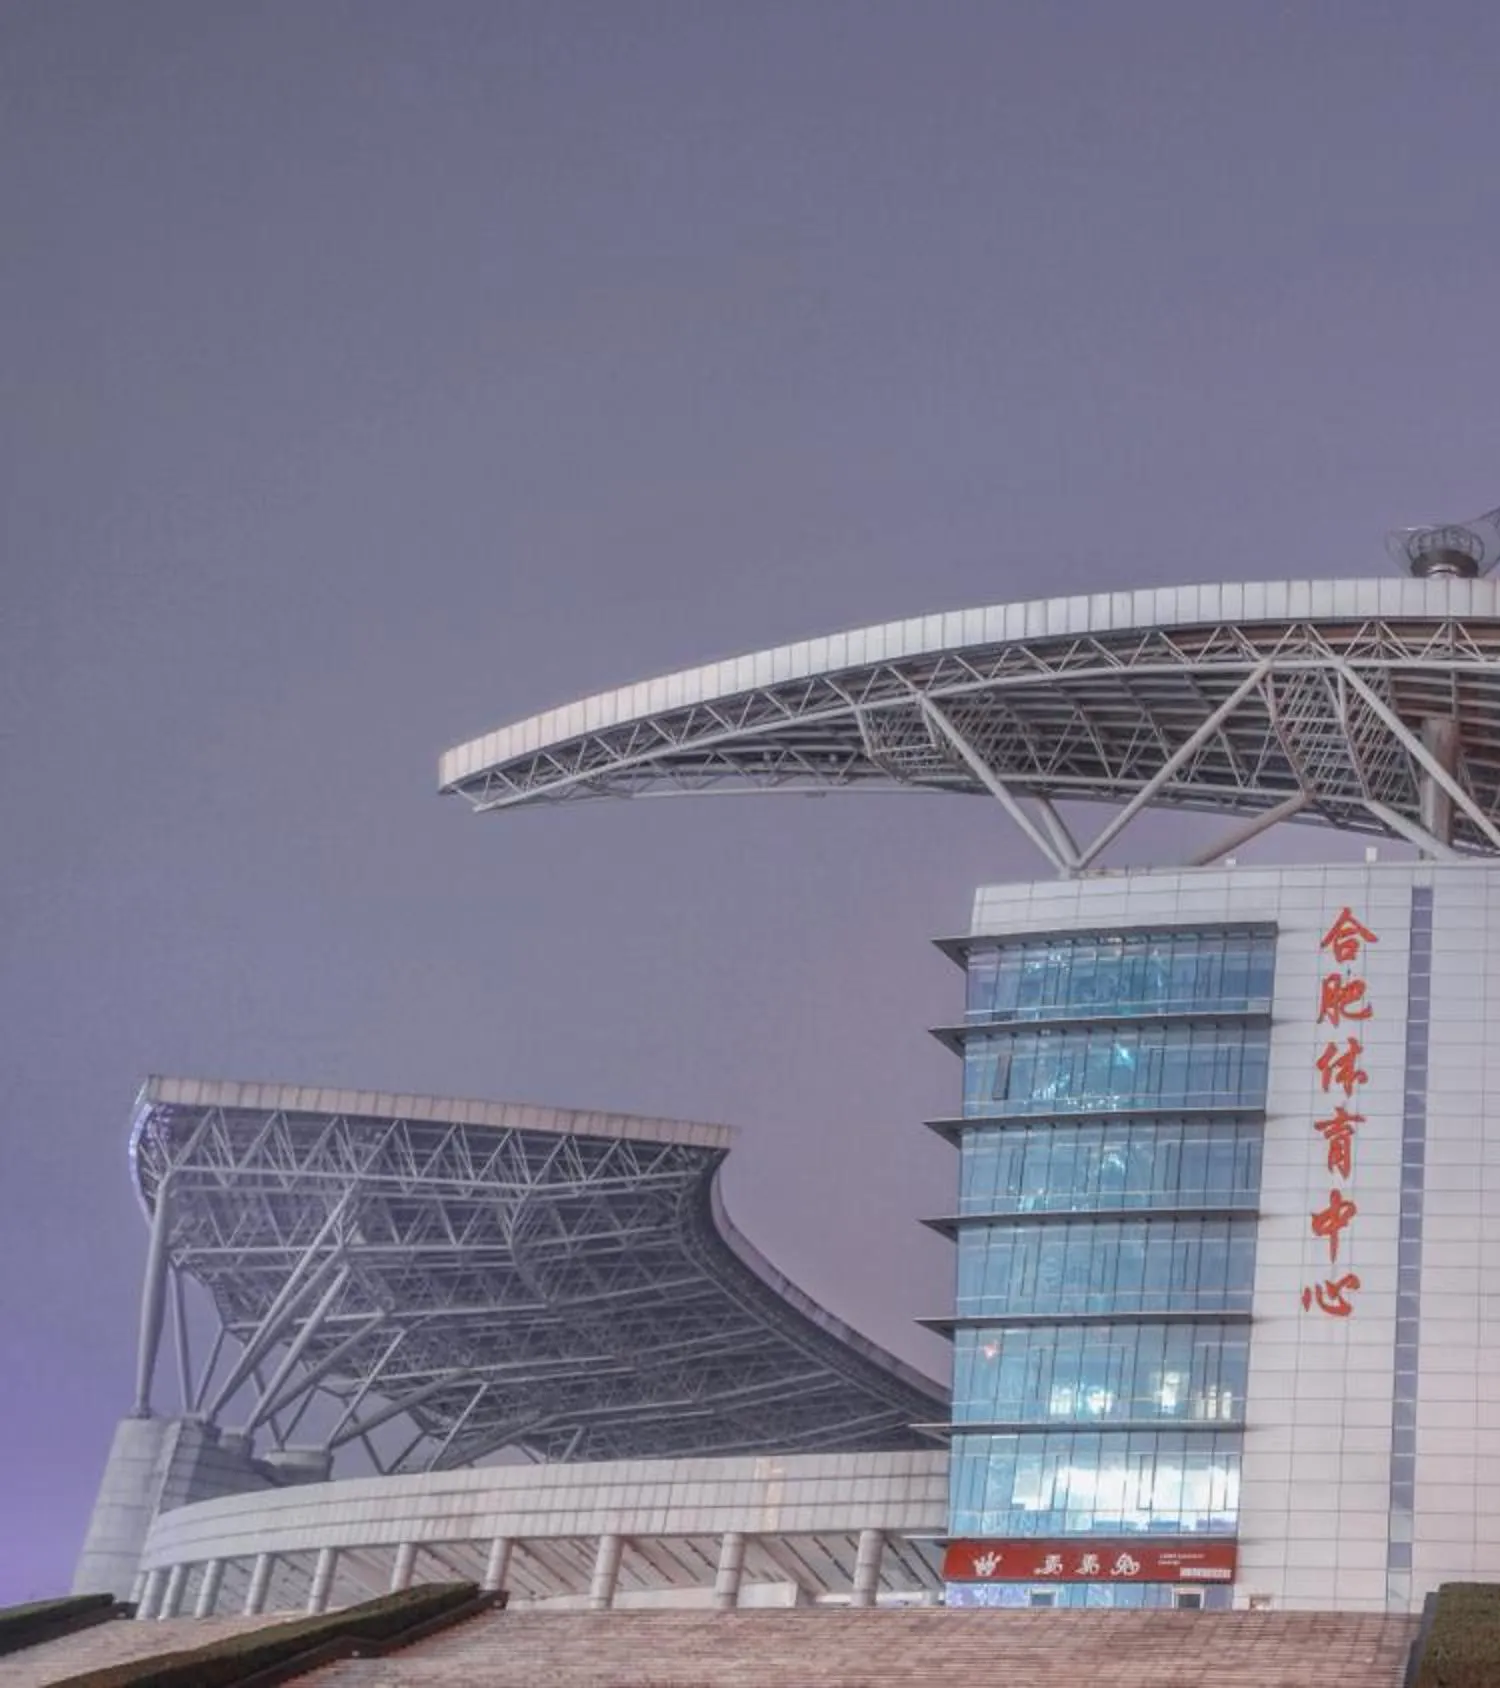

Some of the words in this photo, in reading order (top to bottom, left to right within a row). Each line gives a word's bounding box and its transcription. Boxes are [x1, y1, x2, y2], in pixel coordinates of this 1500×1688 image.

[1301, 907, 1377, 1316] 合肥体育中心
